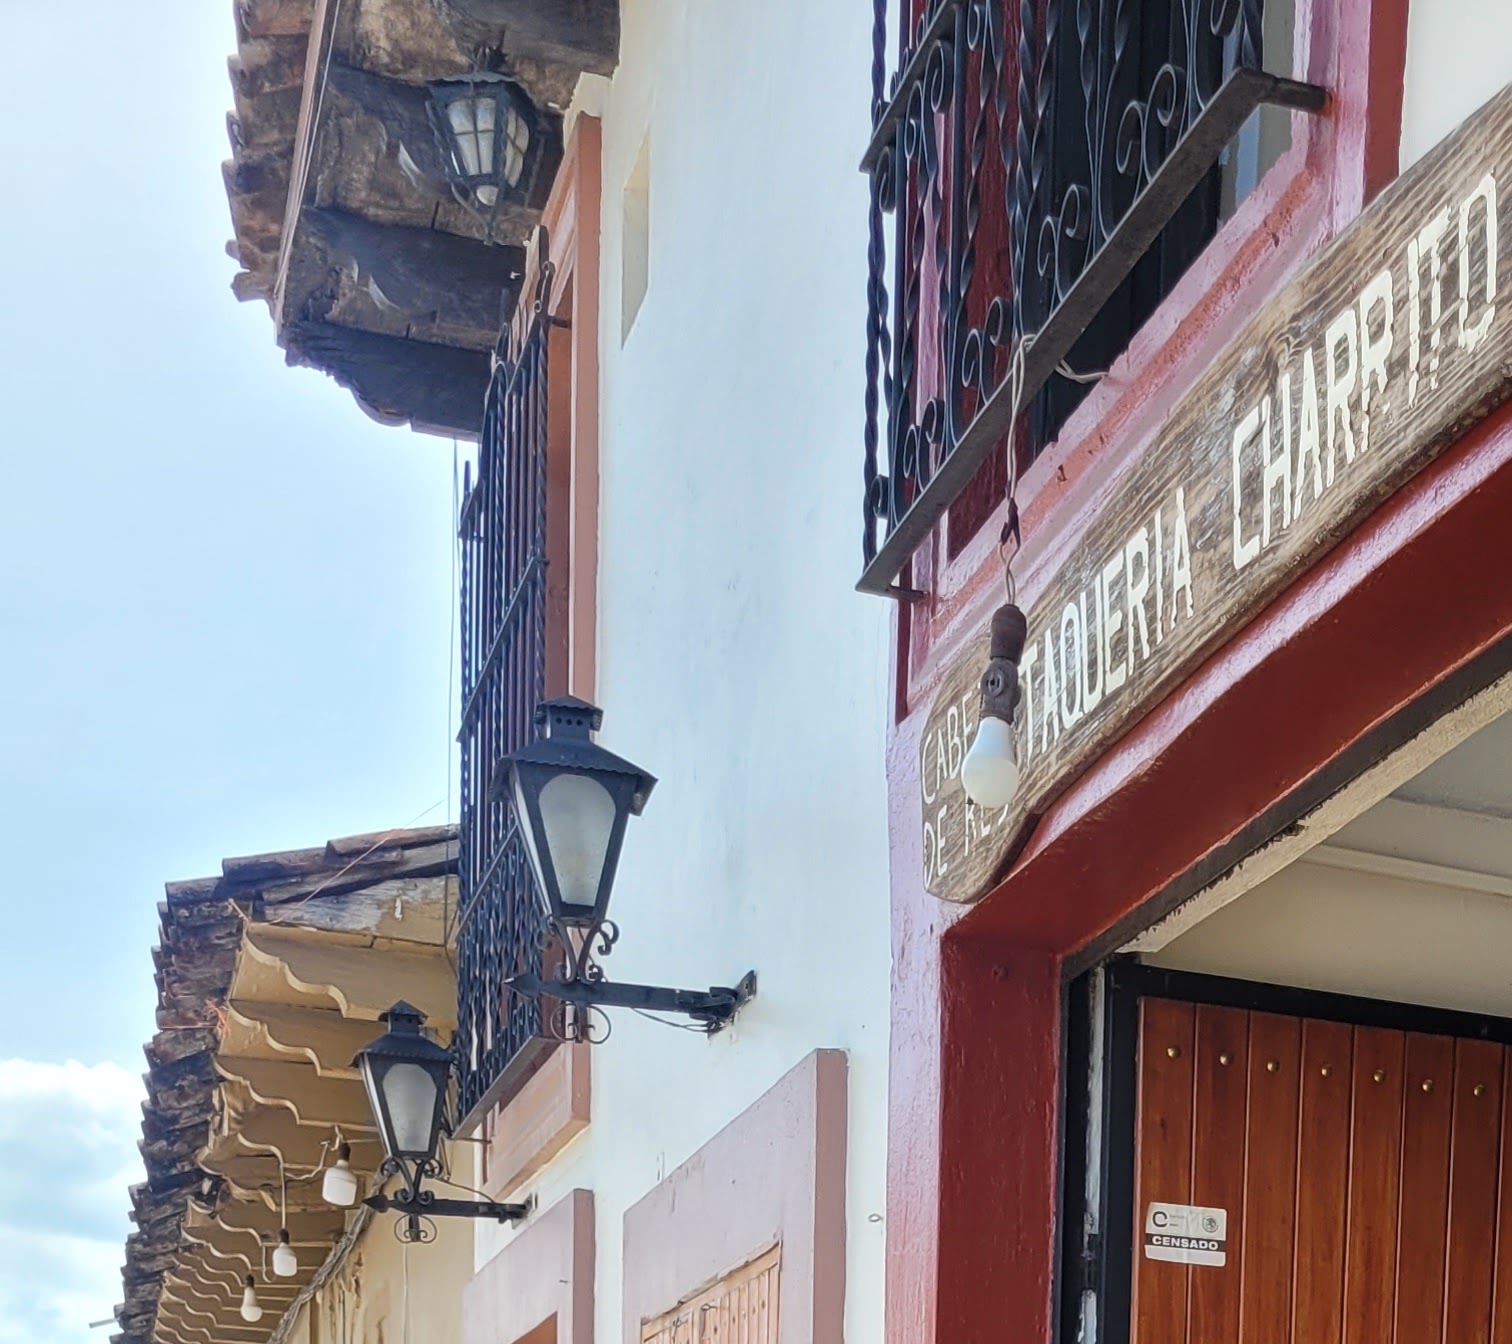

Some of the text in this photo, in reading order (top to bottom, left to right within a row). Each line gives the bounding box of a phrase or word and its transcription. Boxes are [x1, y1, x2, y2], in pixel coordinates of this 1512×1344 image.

[1018, 170, 1497, 768] TAQUERIA CHARRITO
[923, 804, 948, 892] DE
[1152, 1235, 1219, 1250] CENSADO
